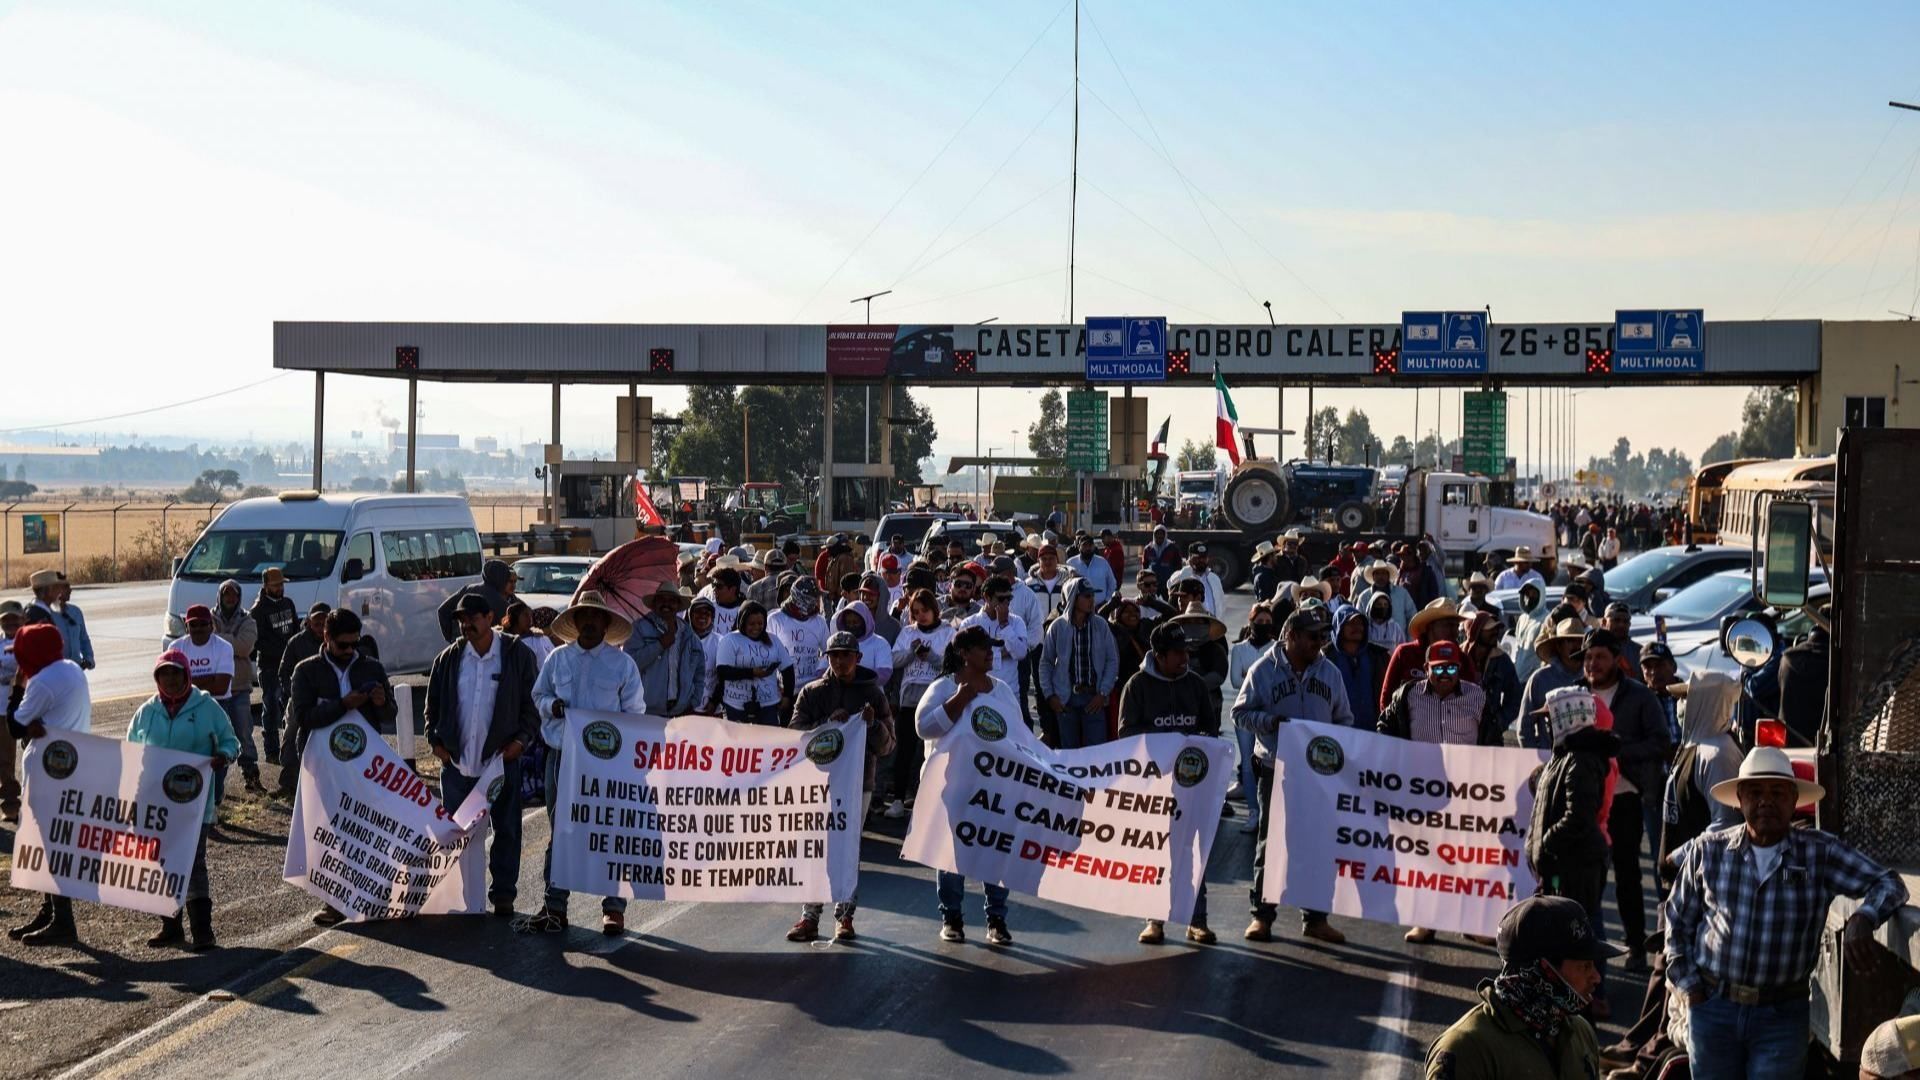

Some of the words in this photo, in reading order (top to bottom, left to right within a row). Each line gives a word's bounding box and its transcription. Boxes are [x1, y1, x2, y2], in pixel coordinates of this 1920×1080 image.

[977, 329, 1086, 357] CASETA
[1175, 329, 1271, 357] COBRO
[1621, 357, 1696, 368] MULTIMODAL
[1090, 363, 1162, 375] MULTIMODAL
[1408, 358, 1480, 368] MULTIMODAL
[748, 644, 770, 659] NO
[791, 629, 805, 641] NO
[190, 658, 210, 667] NO
[634, 739, 714, 771] SABÍAS
[720, 746, 764, 777] QUE
[770, 747, 799, 771] ??
[1050, 758, 1162, 780] COMIDA
[580, 774, 599, 798] LA
[606, 779, 659, 801] NUEVA
[665, 786, 741, 806] REFORMA
[747, 786, 768, 805] DE
[774, 785, 795, 805] LA
[973, 751, 1096, 805] QUIEREN
[1104, 788, 1182, 821] TENER,
[1359, 769, 1403, 791] ¡NO
[1409, 777, 1506, 802] SOMOS
[59, 789, 84, 816] ¡EL
[90, 794, 138, 828] AGUA
[143, 804, 169, 832] ES
[339, 791, 354, 811] TU
[353, 803, 399, 835] VOLUMEN
[399, 824, 415, 844] DE
[571, 803, 590, 824] NO
[595, 807, 614, 826] LE
[620, 808, 698, 834] INTERESA
[703, 813, 735, 836] QUE
[741, 813, 772, 833] TUS
[778, 811, 847, 832] TIERRAS
[968, 789, 1006, 816] AL
[1014, 801, 1116, 843] CAMPO
[1121, 827, 1171, 851] HAY
[1336, 793, 1366, 815] EL
[1374, 802, 1526, 838] PROBLEMA,
[49, 818, 74, 846] UN
[77, 823, 165, 868] DERECHO,
[313, 826, 341, 851] ENDE
[339, 841, 347, 855] A
[346, 844, 366, 865] LAS
[366, 855, 411, 886] GRANDES
[412, 873, 444, 889] INDU
[330, 813, 340, 827] A
[339, 817, 375, 846] MANOS
[373, 835, 392, 857] DEL
[392, 846, 442, 870] GOBIERNO
[589, 832, 609, 853] DE
[614, 833, 662, 858] RIEGO
[668, 841, 689, 860] SE
[695, 840, 798, 861] CONVIERTAN
[804, 839, 825, 859] EN
[955, 821, 1015, 854] QUE
[1019, 840, 1165, 886] DEFENDER!
[1336, 826, 1430, 856] SOMOS
[1436, 843, 1520, 867] QUIEN
[17, 844, 44, 872] NO
[48, 850, 74, 878] UN
[77, 856, 186, 900] PRIVILEGIO!
[309, 868, 353, 908] LECHERAS,
[320, 850, 393, 903] (REFRESQUERAS,
[607, 862, 675, 886] TIERRAS
[681, 868, 702, 888] DE
[709, 867, 803, 888] TEMPORAL.
[1334, 858, 1366, 879] TE
[1371, 865, 1516, 901] ALIMENTA!
